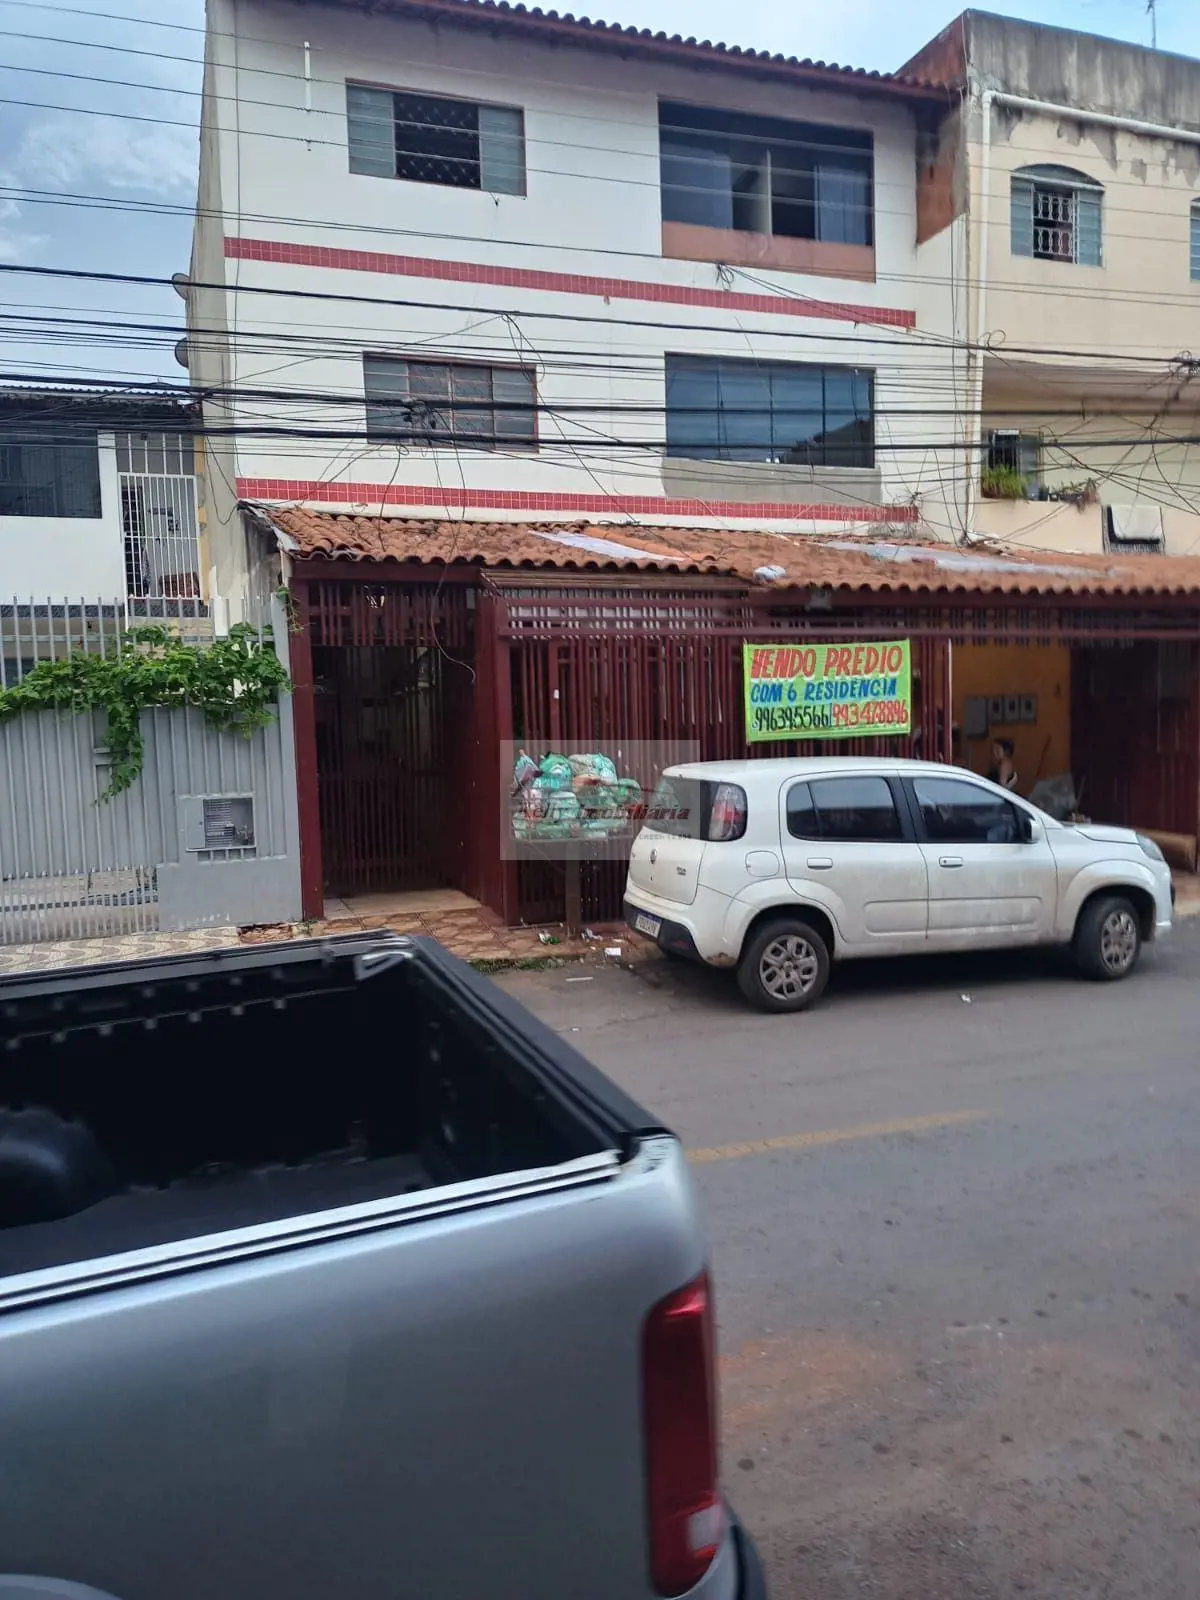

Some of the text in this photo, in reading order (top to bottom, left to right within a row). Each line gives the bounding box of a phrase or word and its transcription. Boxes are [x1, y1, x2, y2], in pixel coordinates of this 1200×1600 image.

[751, 645, 903, 679] VENDO PREDIO
[751, 683, 783, 703] COM
[787, 683, 798, 703] 6
